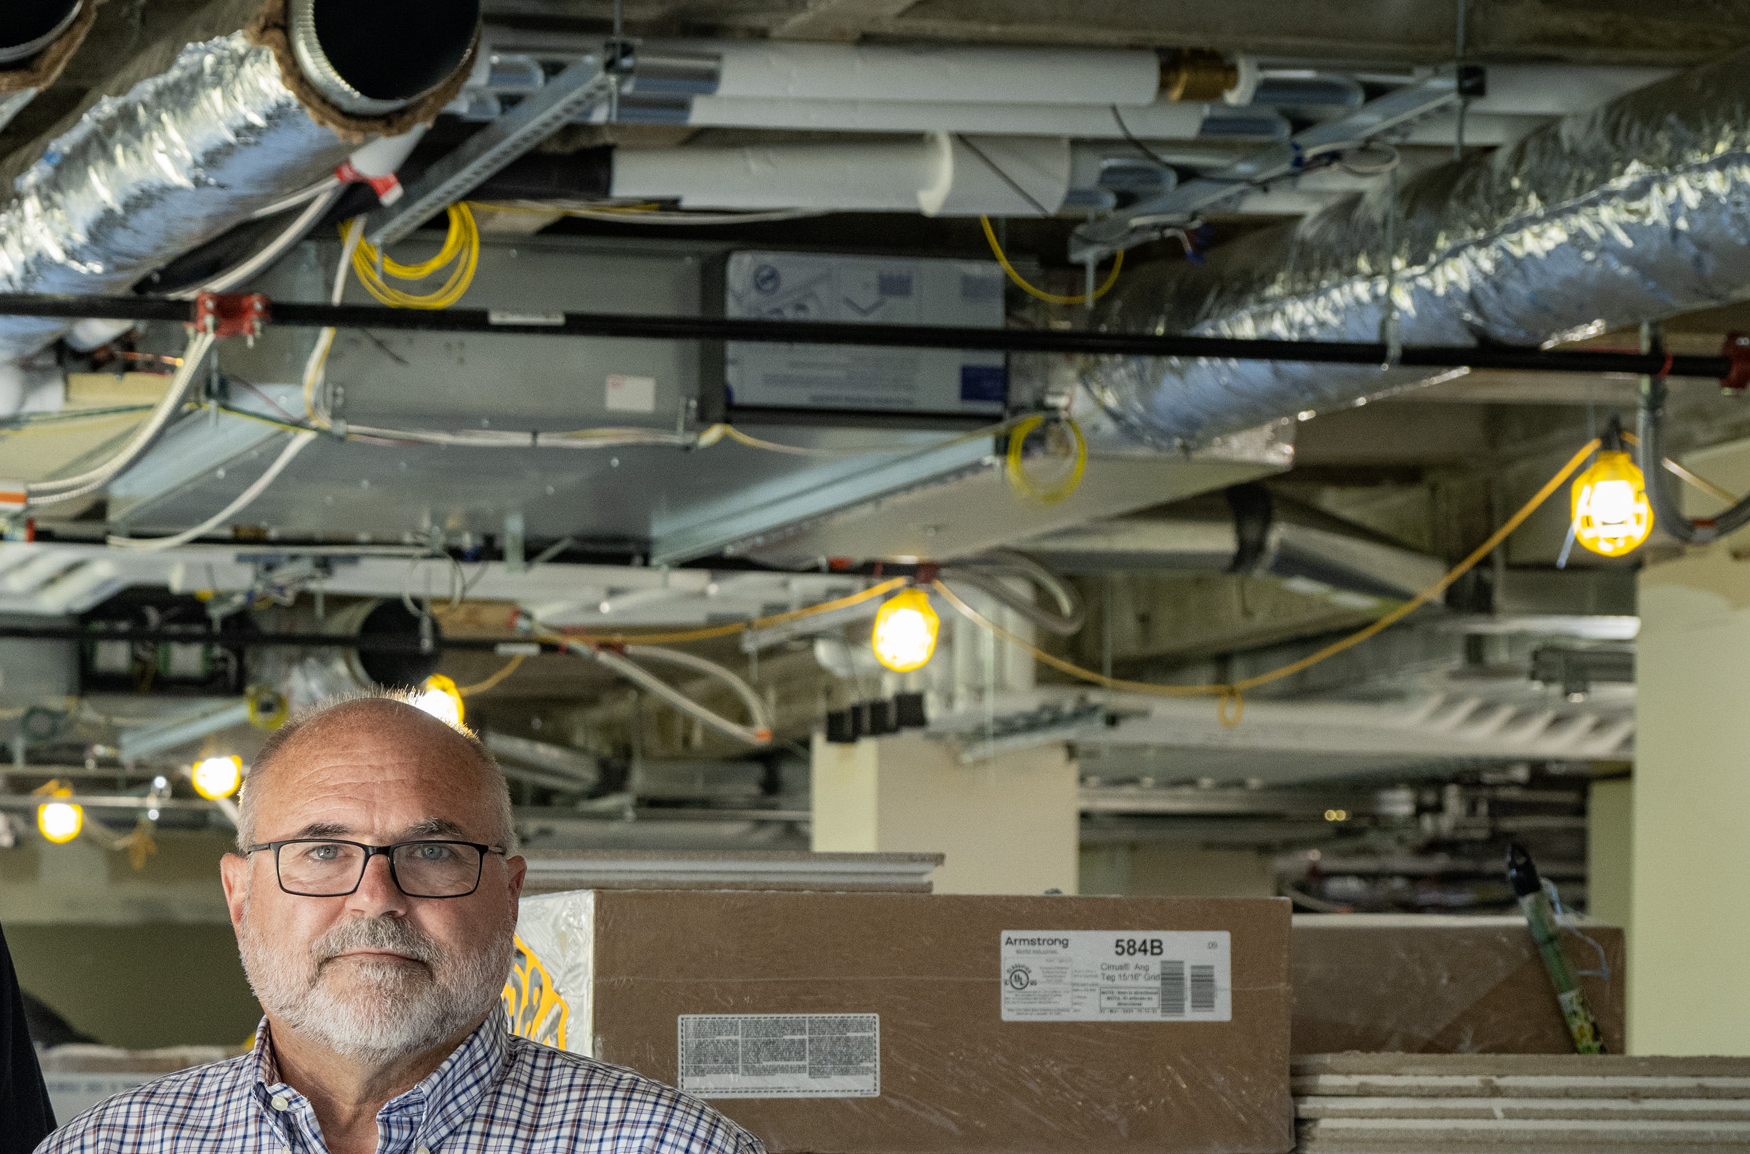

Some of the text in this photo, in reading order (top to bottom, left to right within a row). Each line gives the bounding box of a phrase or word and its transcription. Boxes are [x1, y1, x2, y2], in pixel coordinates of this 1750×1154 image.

[1005, 936, 1069, 949] Armstrong
[1115, 939, 1164, 956] 584B
[1134, 962, 1150, 972] Ang
[1144, 973, 1161, 981] Grid
